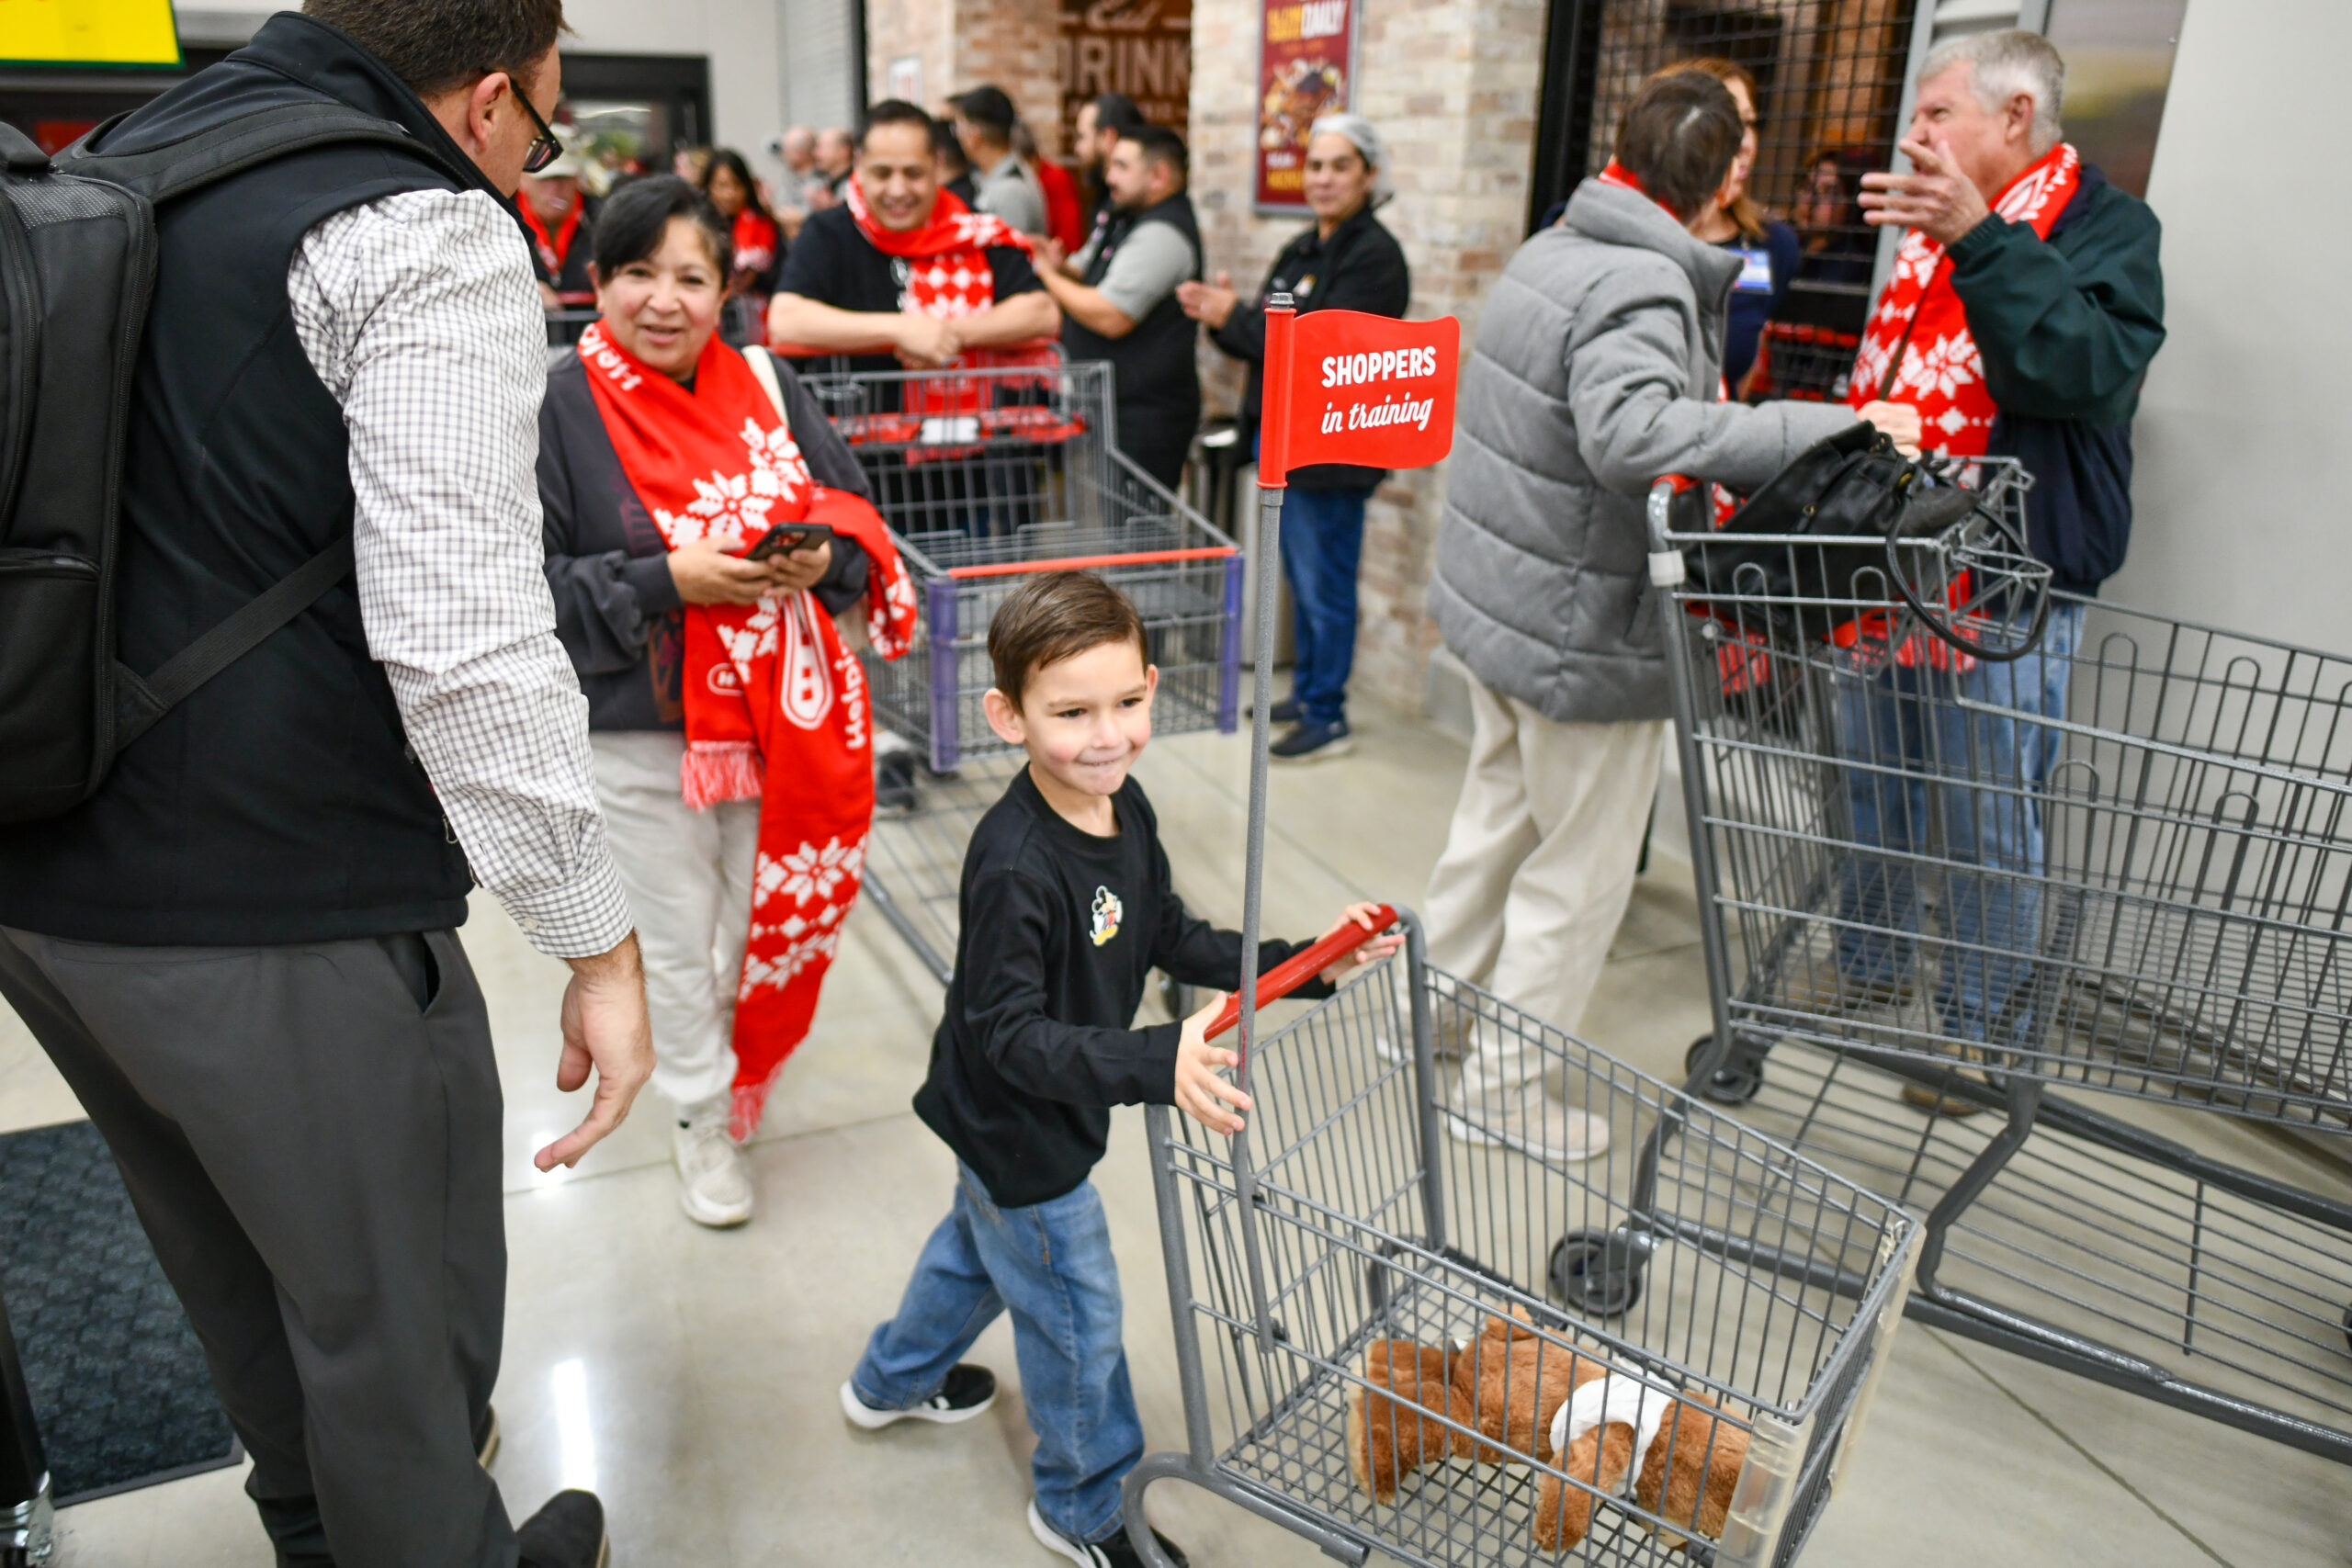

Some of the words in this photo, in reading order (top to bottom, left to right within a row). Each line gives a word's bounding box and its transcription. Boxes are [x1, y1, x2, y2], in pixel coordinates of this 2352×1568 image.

[1321, 345, 1437, 388] SHOPPERS
[1320, 401, 1343, 434] in
[1348, 391, 1434, 431] training
